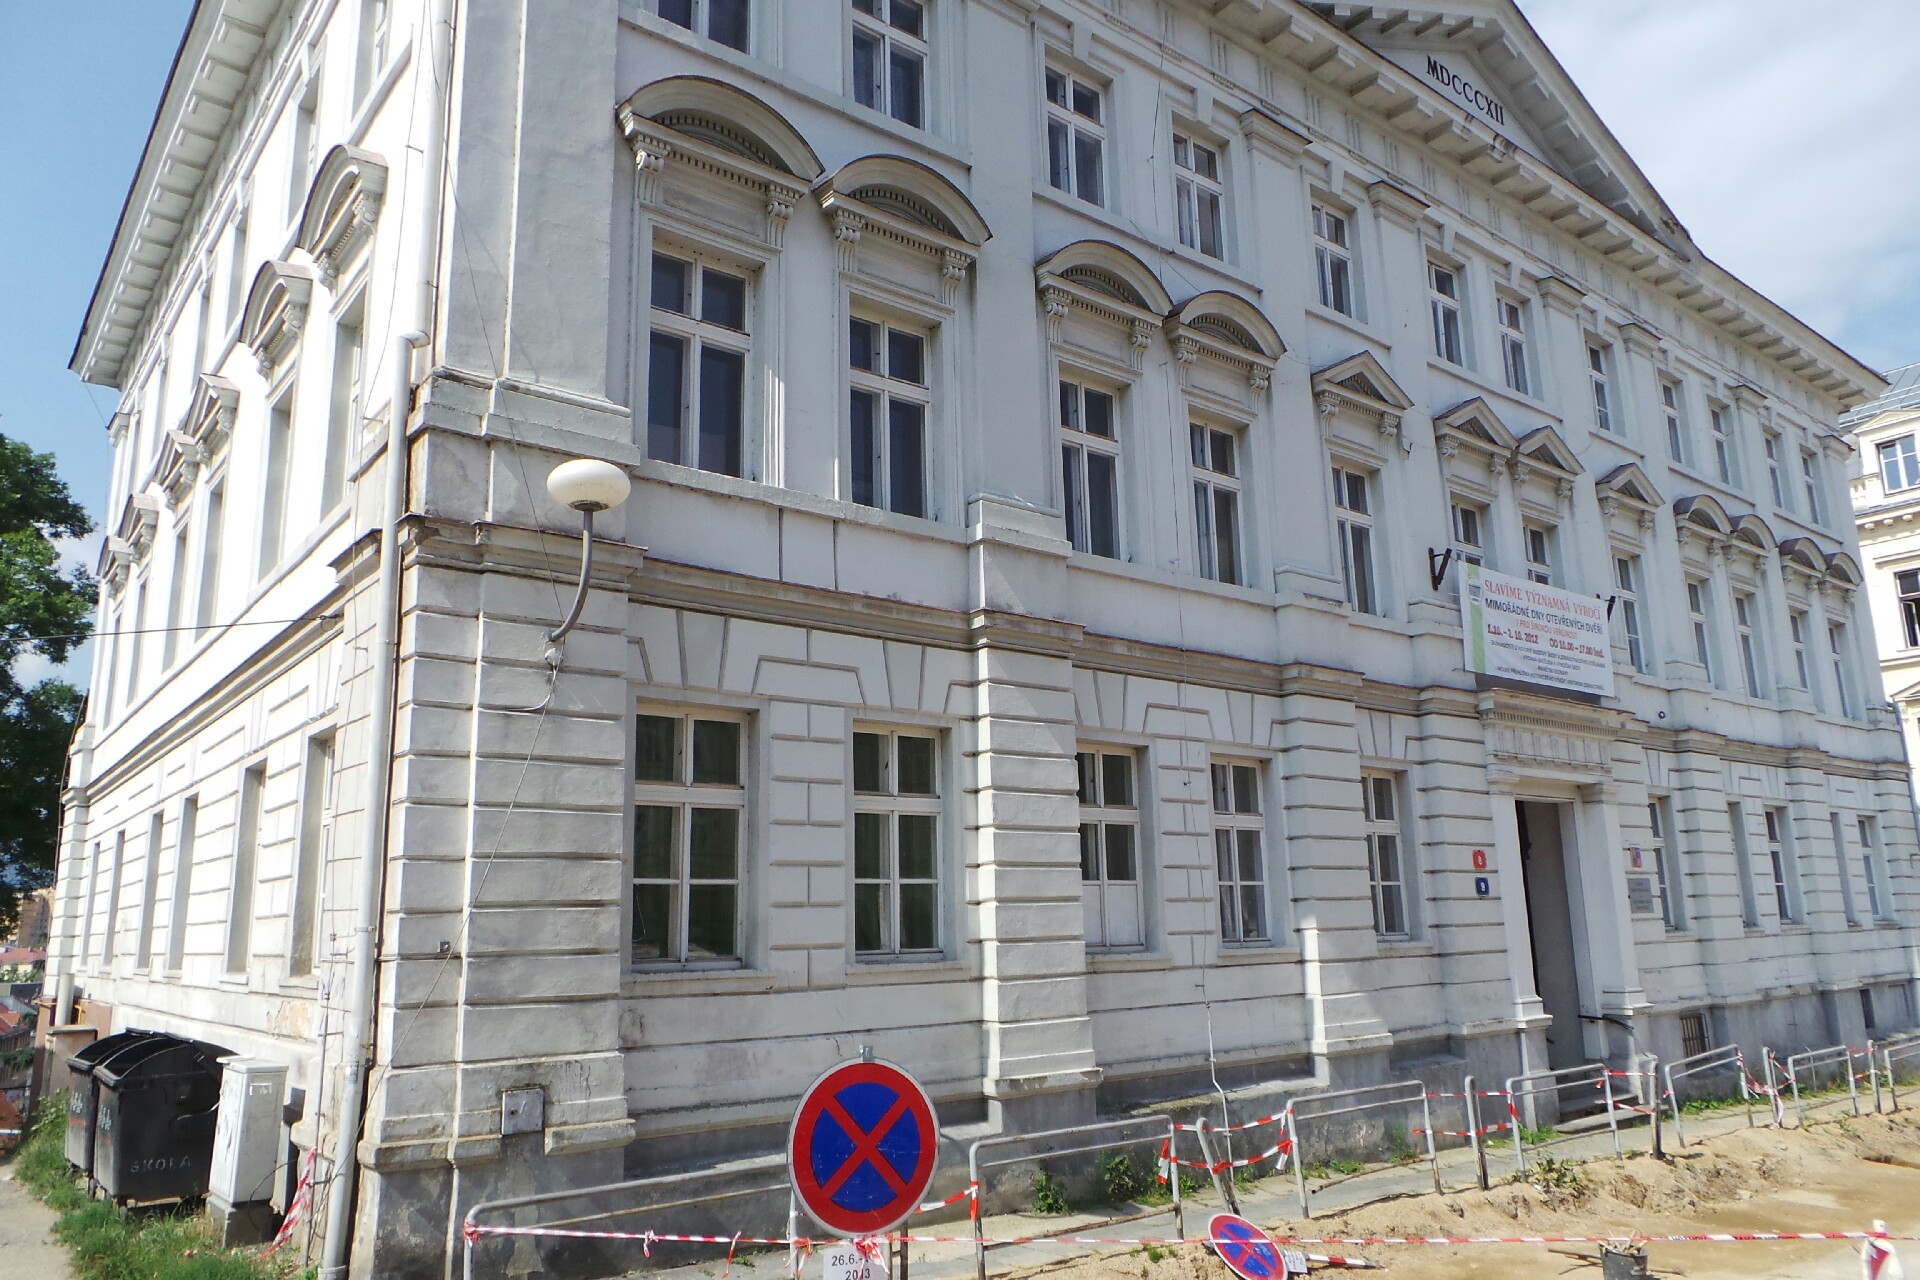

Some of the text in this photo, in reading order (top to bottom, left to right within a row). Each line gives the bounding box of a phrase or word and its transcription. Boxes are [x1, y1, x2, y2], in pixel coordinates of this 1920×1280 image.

[1427, 55, 1504, 126] MDCCCXII
[1485, 579, 1522, 600] SLAVÍME
[1526, 589, 1570, 613] VÝZNAMNÁ
[1485, 598, 1530, 618] MIMOŘÁDNÉ
[1531, 609, 1545, 621] DNY
[1546, 613, 1585, 631] OTEVŘENÝCH
